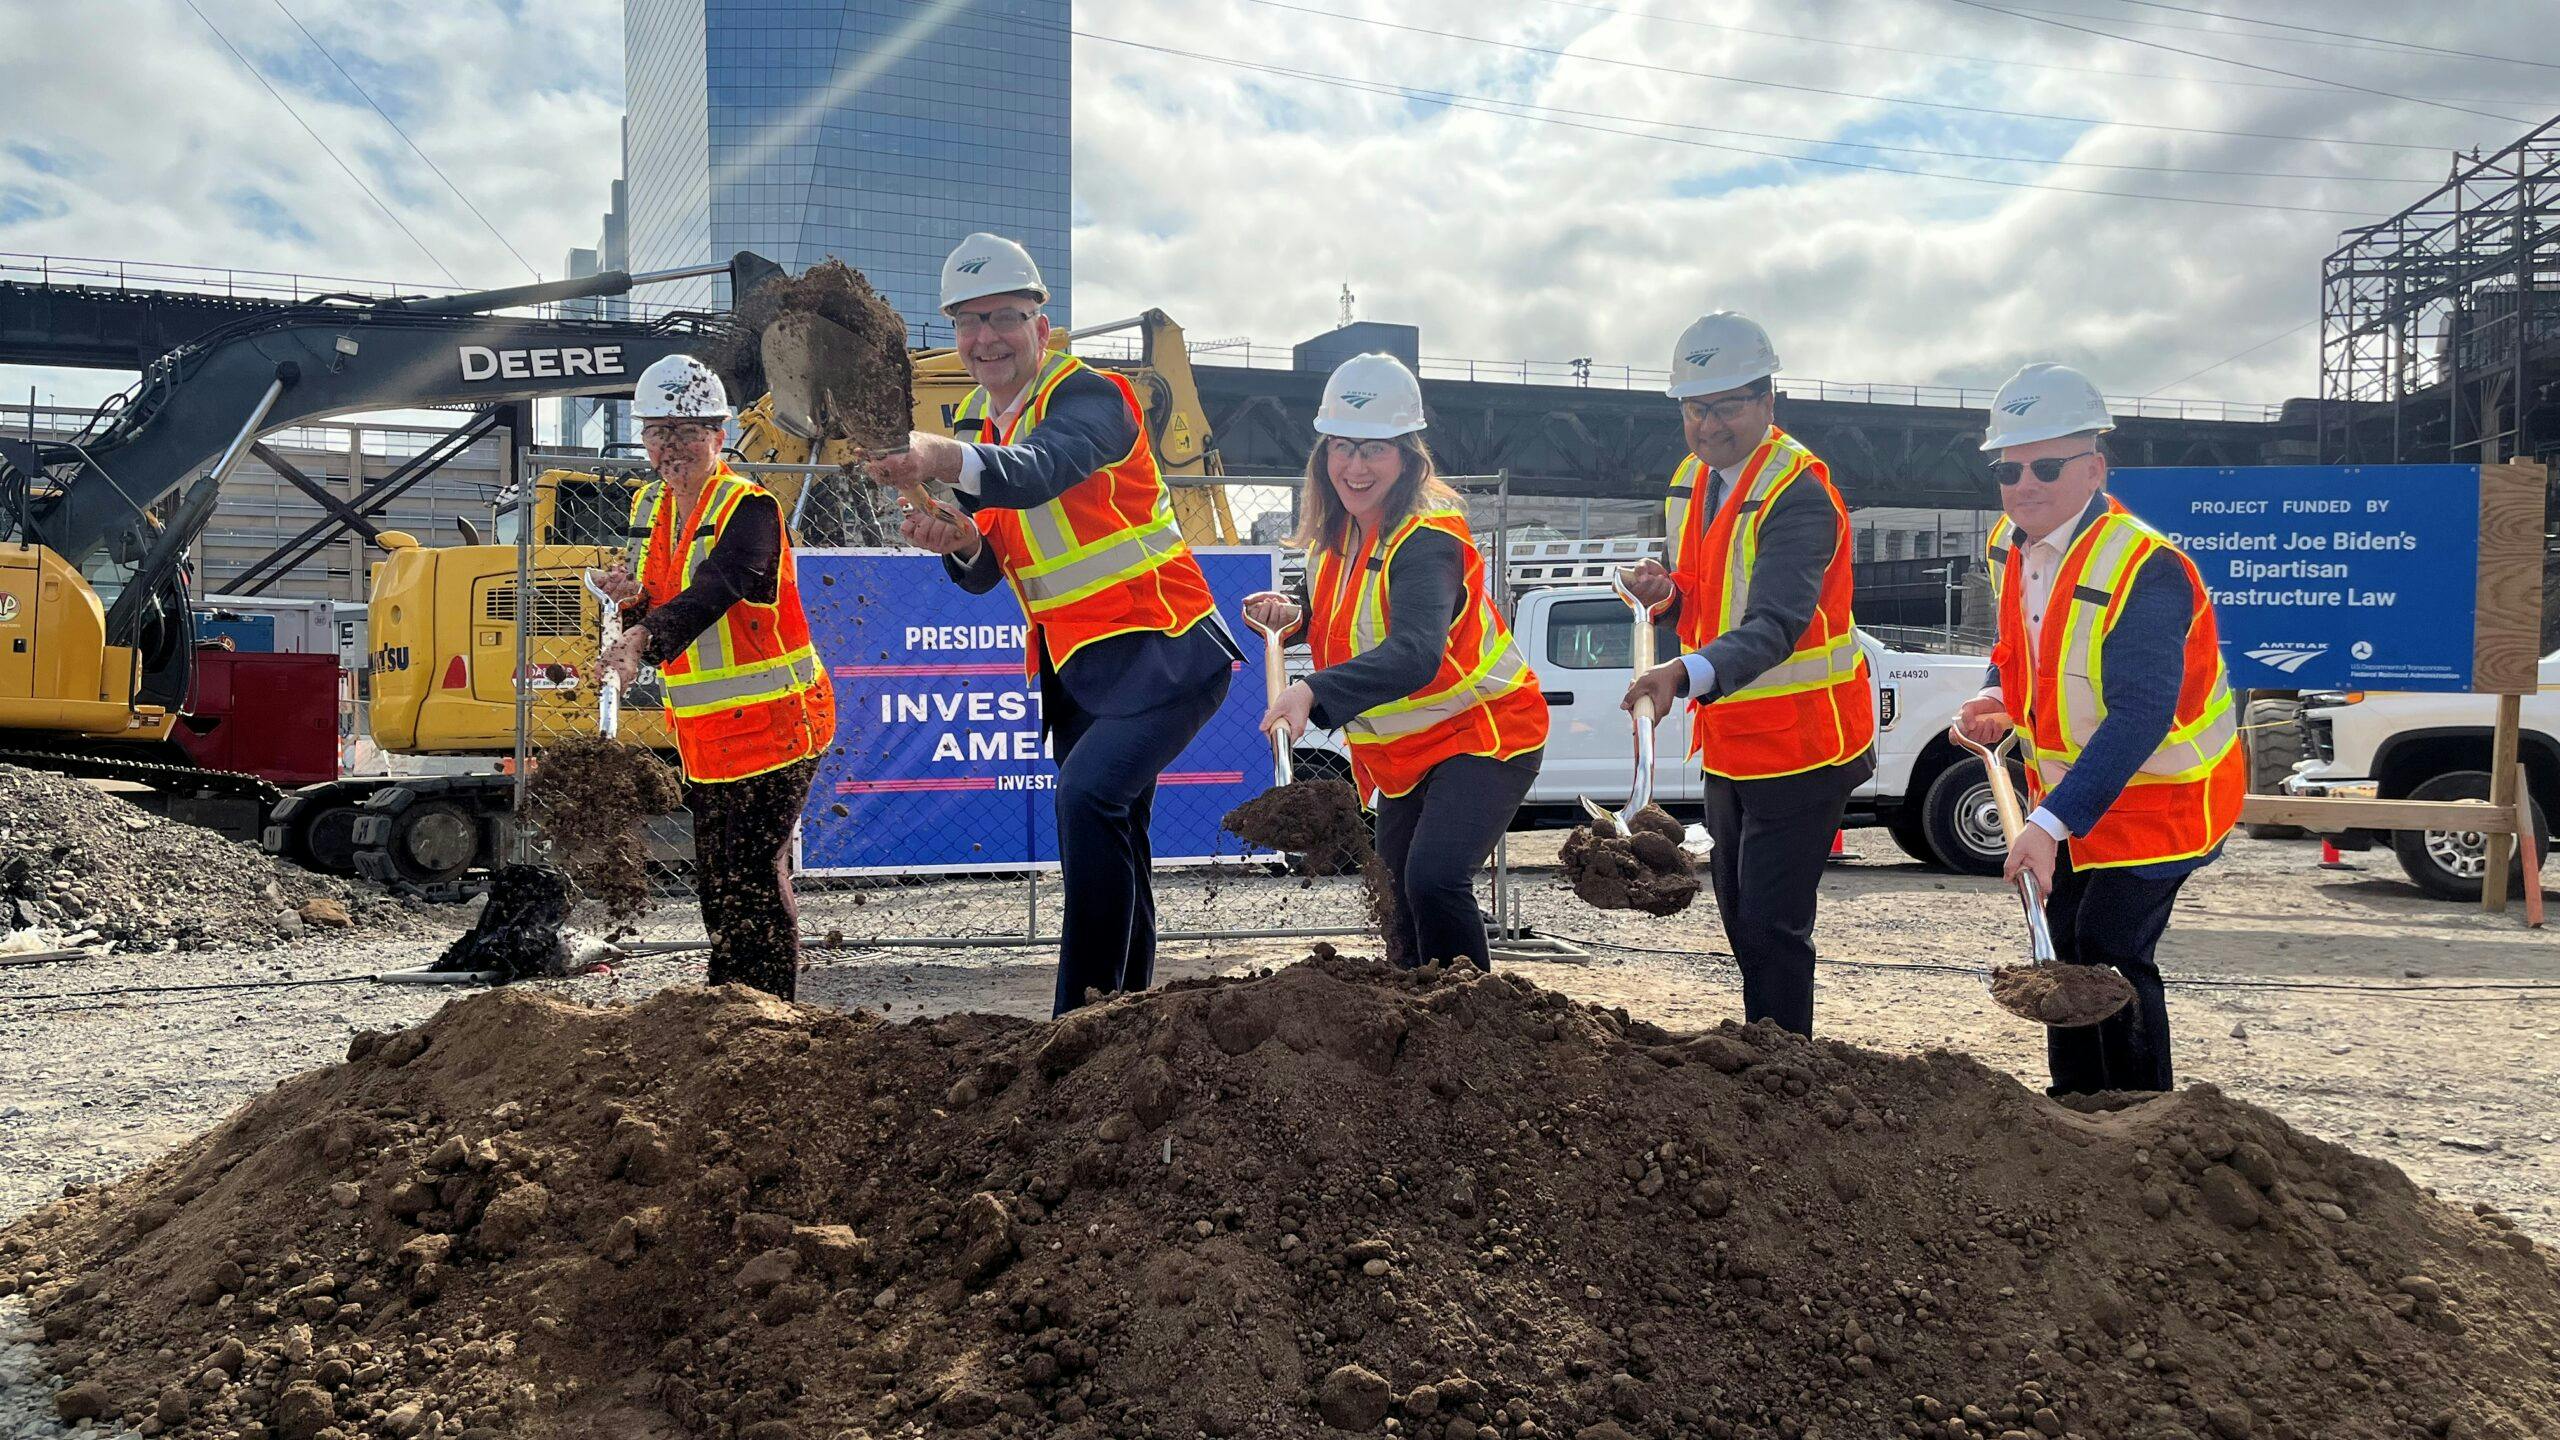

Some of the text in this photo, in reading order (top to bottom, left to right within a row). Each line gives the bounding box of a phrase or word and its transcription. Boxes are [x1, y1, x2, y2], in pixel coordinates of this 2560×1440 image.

[459, 346, 624, 381] DEERE
[2191, 500, 2389, 514] PROJECT FUNDED BY
[2168, 532, 2277, 550] President
[2282, 532, 2327, 550] Joe
[2229, 560, 2347, 582] Bipartisan
[2206, 586, 2396, 606] frastructure Law
[905, 625, 1027, 650] PRESIDEN
[1889, 670, 1929, 679] AE44920
[881, 691, 1043, 723] INVEST
[932, 731, 1054, 762] AME
[998, 774, 1058, 791] INVEST.
